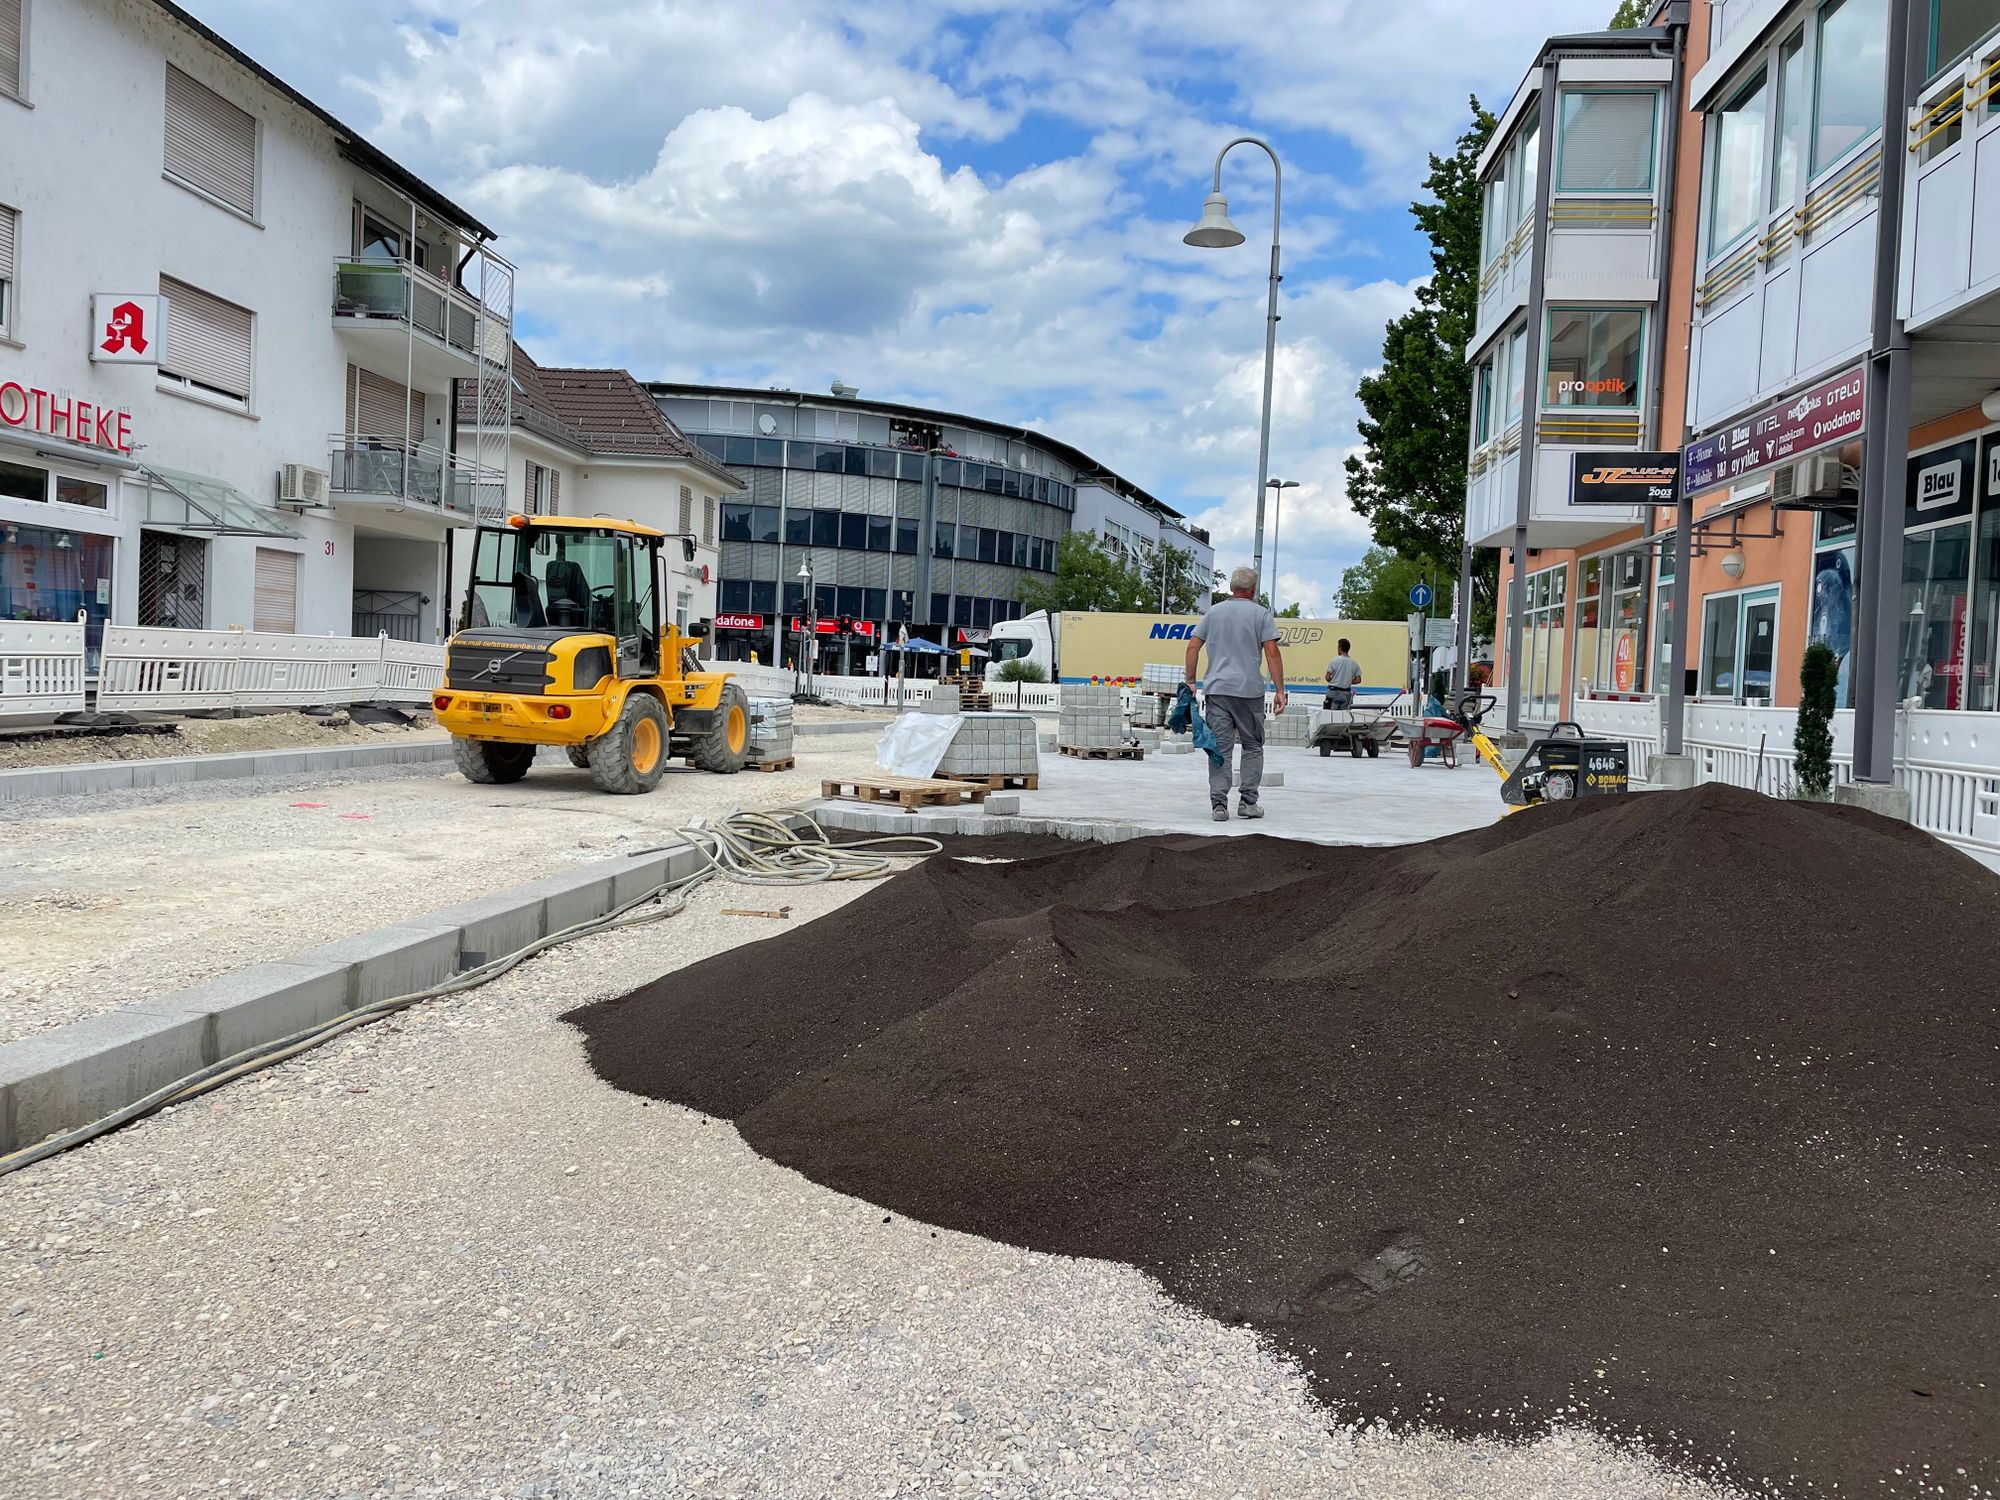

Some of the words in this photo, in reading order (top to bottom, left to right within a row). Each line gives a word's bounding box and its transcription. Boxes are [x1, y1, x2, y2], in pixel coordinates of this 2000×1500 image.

[0, 382, 132, 452] OTHEKE
[1822, 408, 1861, 434] vodafone
[1731, 426, 1750, 444] Blau
[1923, 471, 1955, 494] Blau
[1648, 488, 1673, 497] 2003
[324, 541, 335, 556] 31
[715, 616, 755, 627] dafone
[1588, 757, 1616, 771] 4646
[1598, 774, 1627, 784] BOMAG
